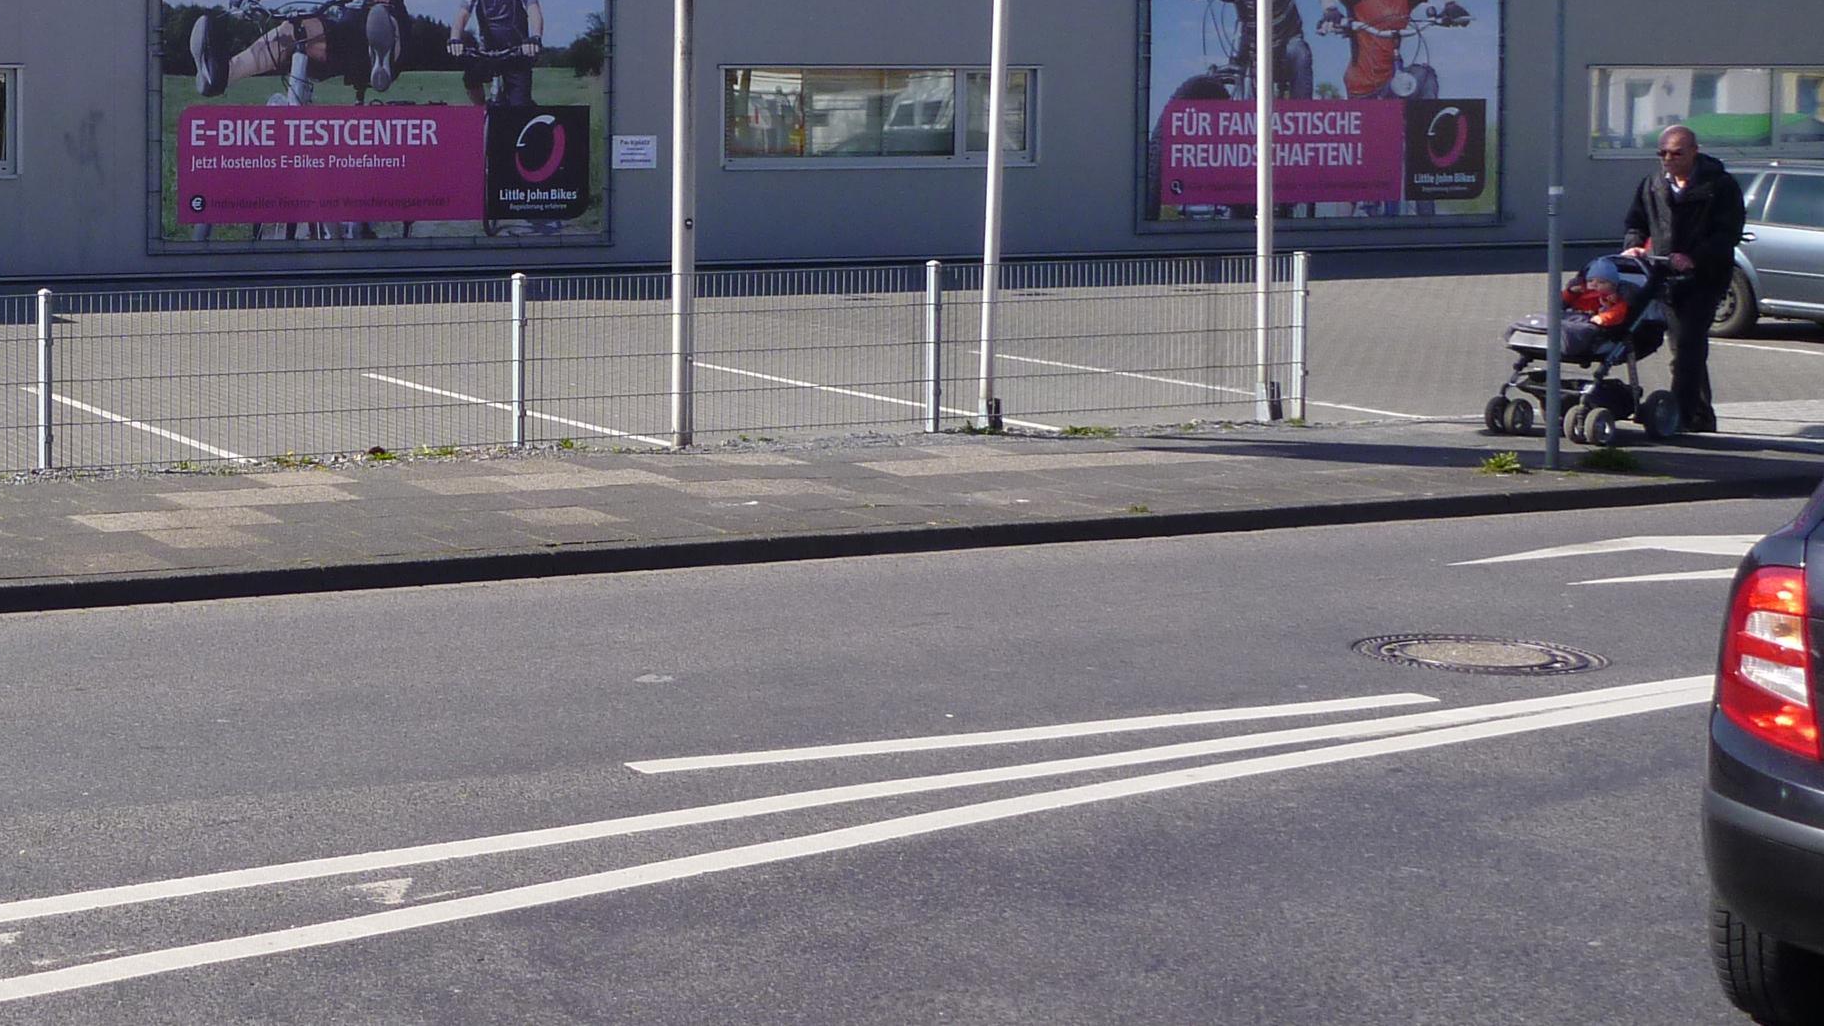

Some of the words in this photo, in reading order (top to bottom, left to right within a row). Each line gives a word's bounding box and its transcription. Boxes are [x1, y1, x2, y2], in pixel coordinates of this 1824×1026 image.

[190, 119, 276, 147] E-BIKE
[284, 119, 438, 146] TESTCENTER
[1171, 108, 1212, 136] FÜR
[1218, 111, 1362, 136] FANASTISCHE
[191, 156, 217, 171] Jetzt
[221, 155, 277, 169] kostenlos
[280, 155, 325, 169] E-Bikes
[328, 154, 406, 168] Probefahren!
[500, 189, 526, 201] Little
[527, 190, 549, 202] John
[550, 189, 577, 200] Bikes
